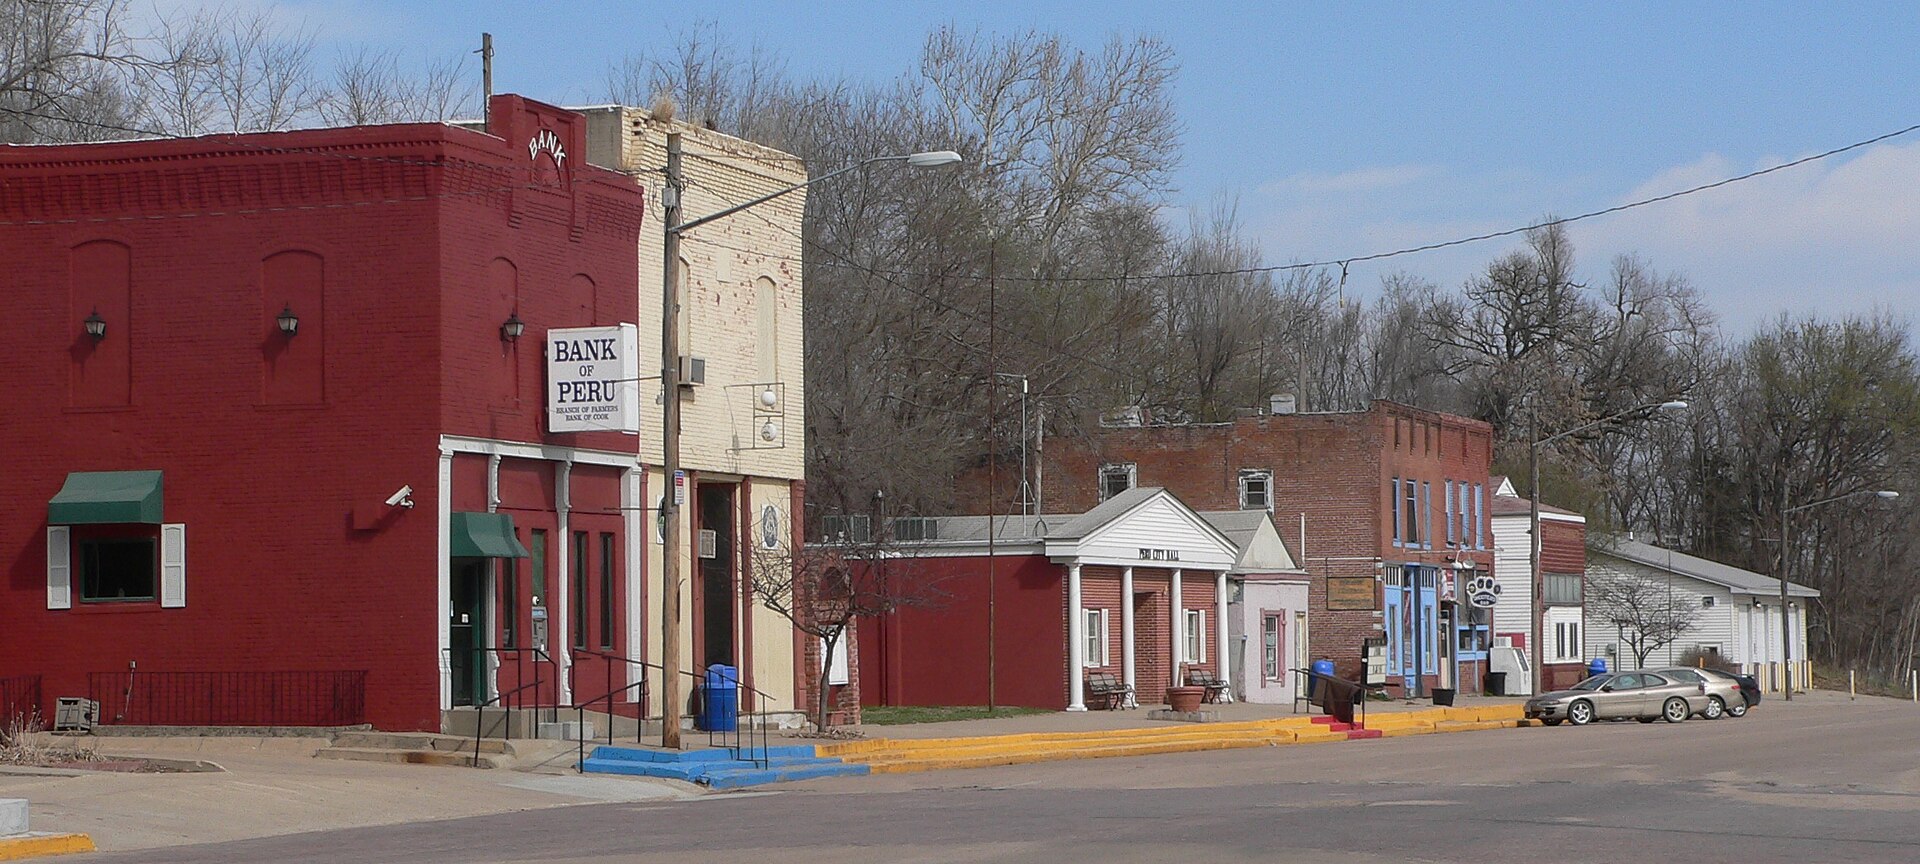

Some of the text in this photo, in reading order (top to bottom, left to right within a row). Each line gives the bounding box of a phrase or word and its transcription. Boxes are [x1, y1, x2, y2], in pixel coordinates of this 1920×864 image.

[529, 129, 567, 168] BANK
[554, 338, 617, 362] BANK
[579, 365, 594, 377] OF
[557, 380, 617, 403] PERU
[556, 406, 580, 414] BRANCH
[591, 405, 618, 413] FARMERS
[593, 413, 609, 421] COOK
